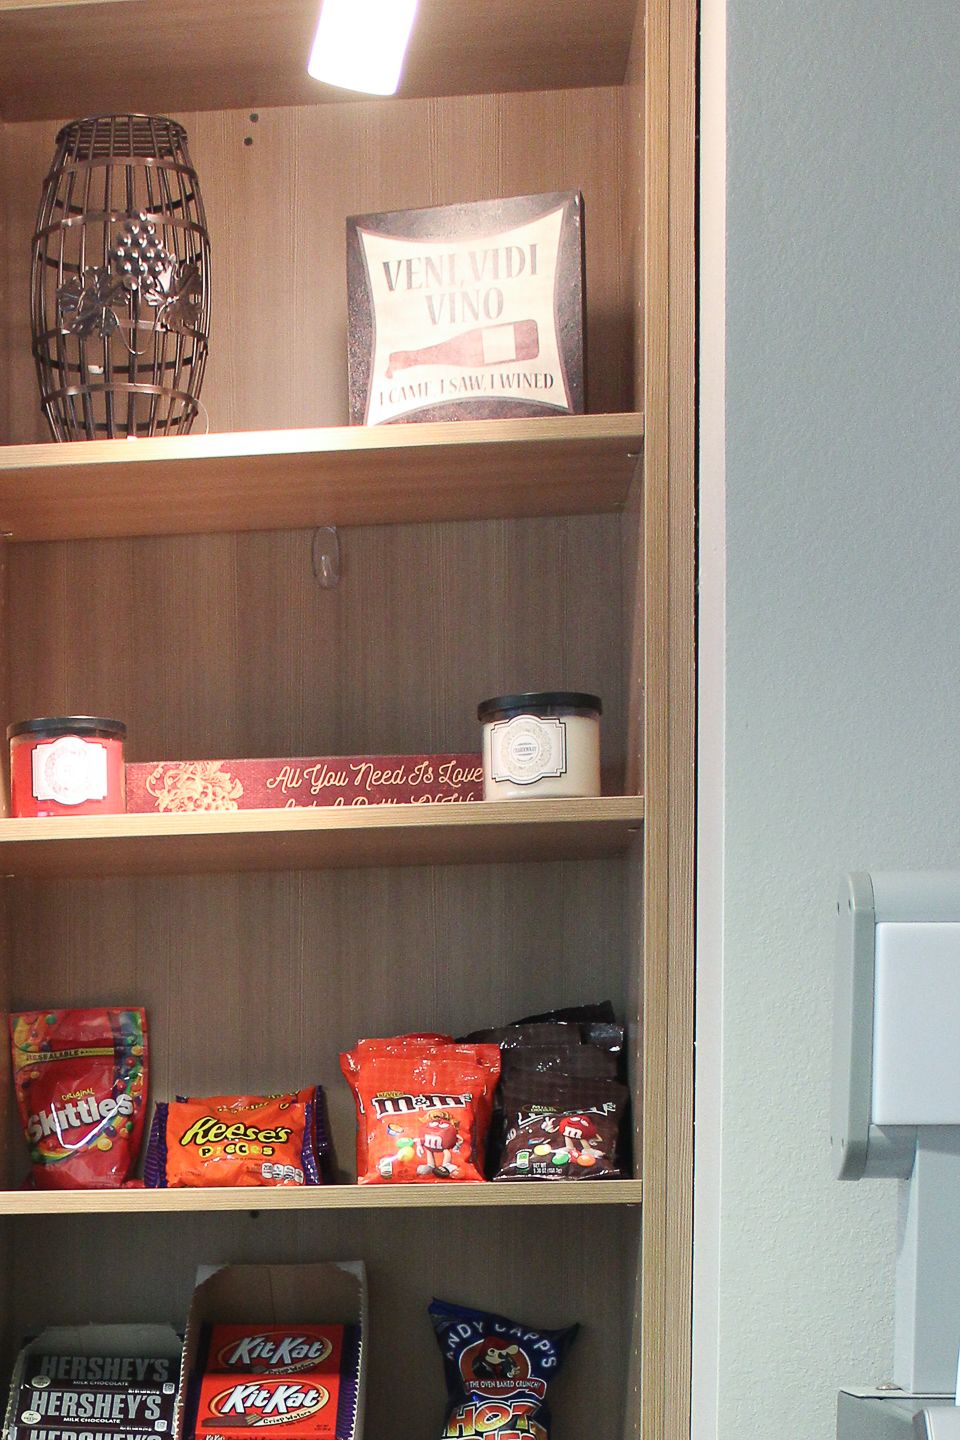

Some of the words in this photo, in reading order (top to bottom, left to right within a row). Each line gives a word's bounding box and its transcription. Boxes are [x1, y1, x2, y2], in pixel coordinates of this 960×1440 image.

[468, 243, 538, 280] VIDI
[424, 287, 505, 326] VINO
[500, 371, 555, 390] WINED
[267, 765, 302, 793] All
[304, 764, 348, 795] You
[350, 762, 406, 790] Need
[408, 760, 434, 786] Is
[439, 760, 483, 787] Love
[27, 1093, 134, 1143] Skittles
[179, 1115, 293, 1146] Reese's
[446, 1321, 484, 1361] ANDY
[481, 1380, 496, 1388] OVEN
[496, 1380, 515, 1388] BAKED
[29, 1390, 162, 1420] HERSHEY'S
[263, 1415, 285, 1425] Crisp
[285, 1410, 312, 1421] Wafers
[444, 1402, 541, 1437] HOT
